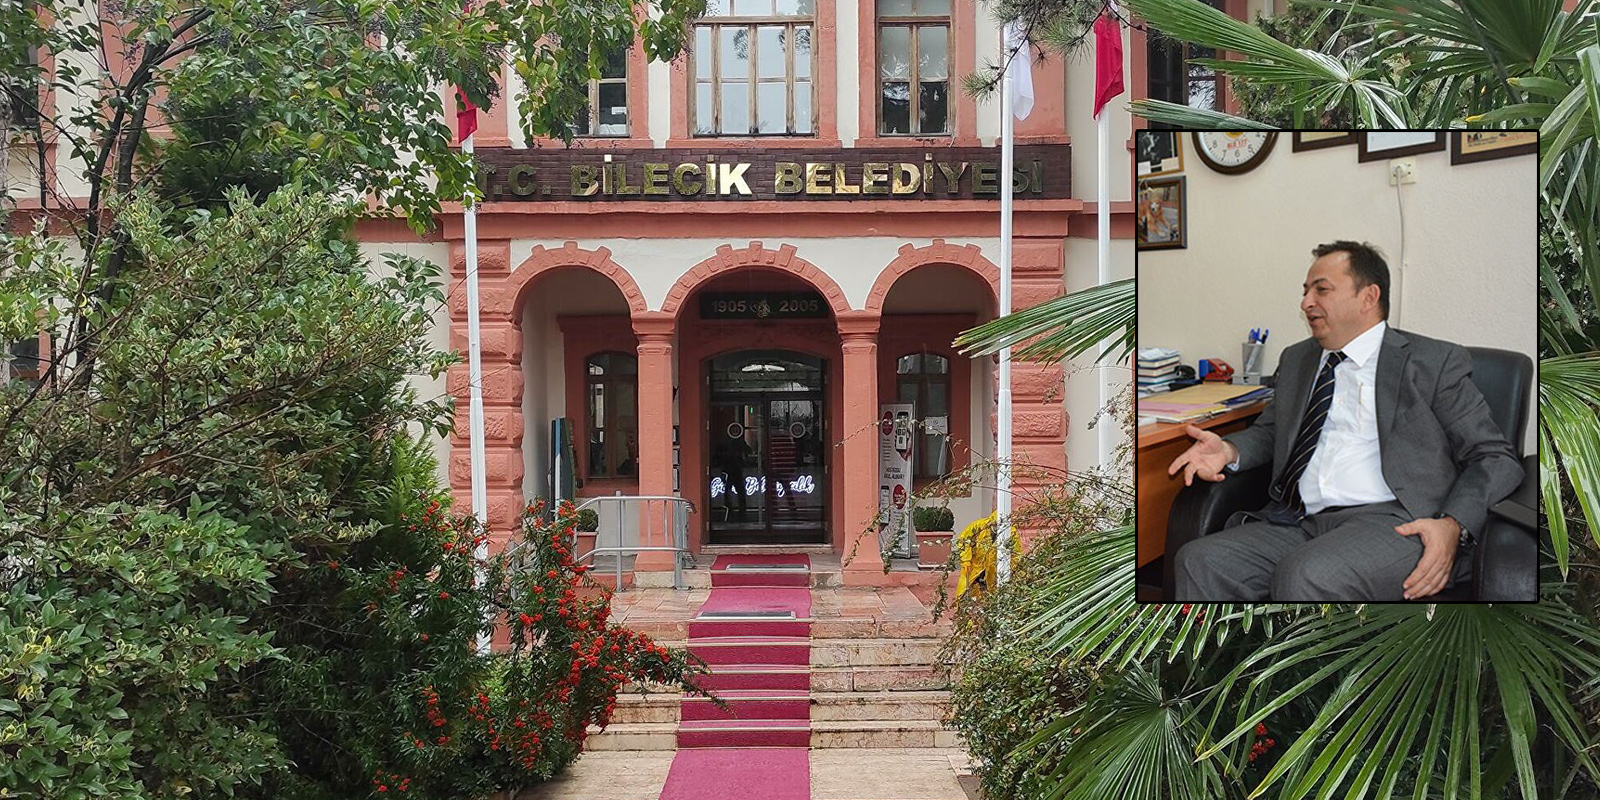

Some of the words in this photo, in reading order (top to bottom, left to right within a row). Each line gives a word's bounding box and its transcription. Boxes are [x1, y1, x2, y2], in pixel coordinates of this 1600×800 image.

[571, 154, 752, 196] BİLECİK
[774, 153, 1043, 194] BELEDİYESİ
[711, 300, 746, 313] 1905
[779, 300, 818, 312] 2005
